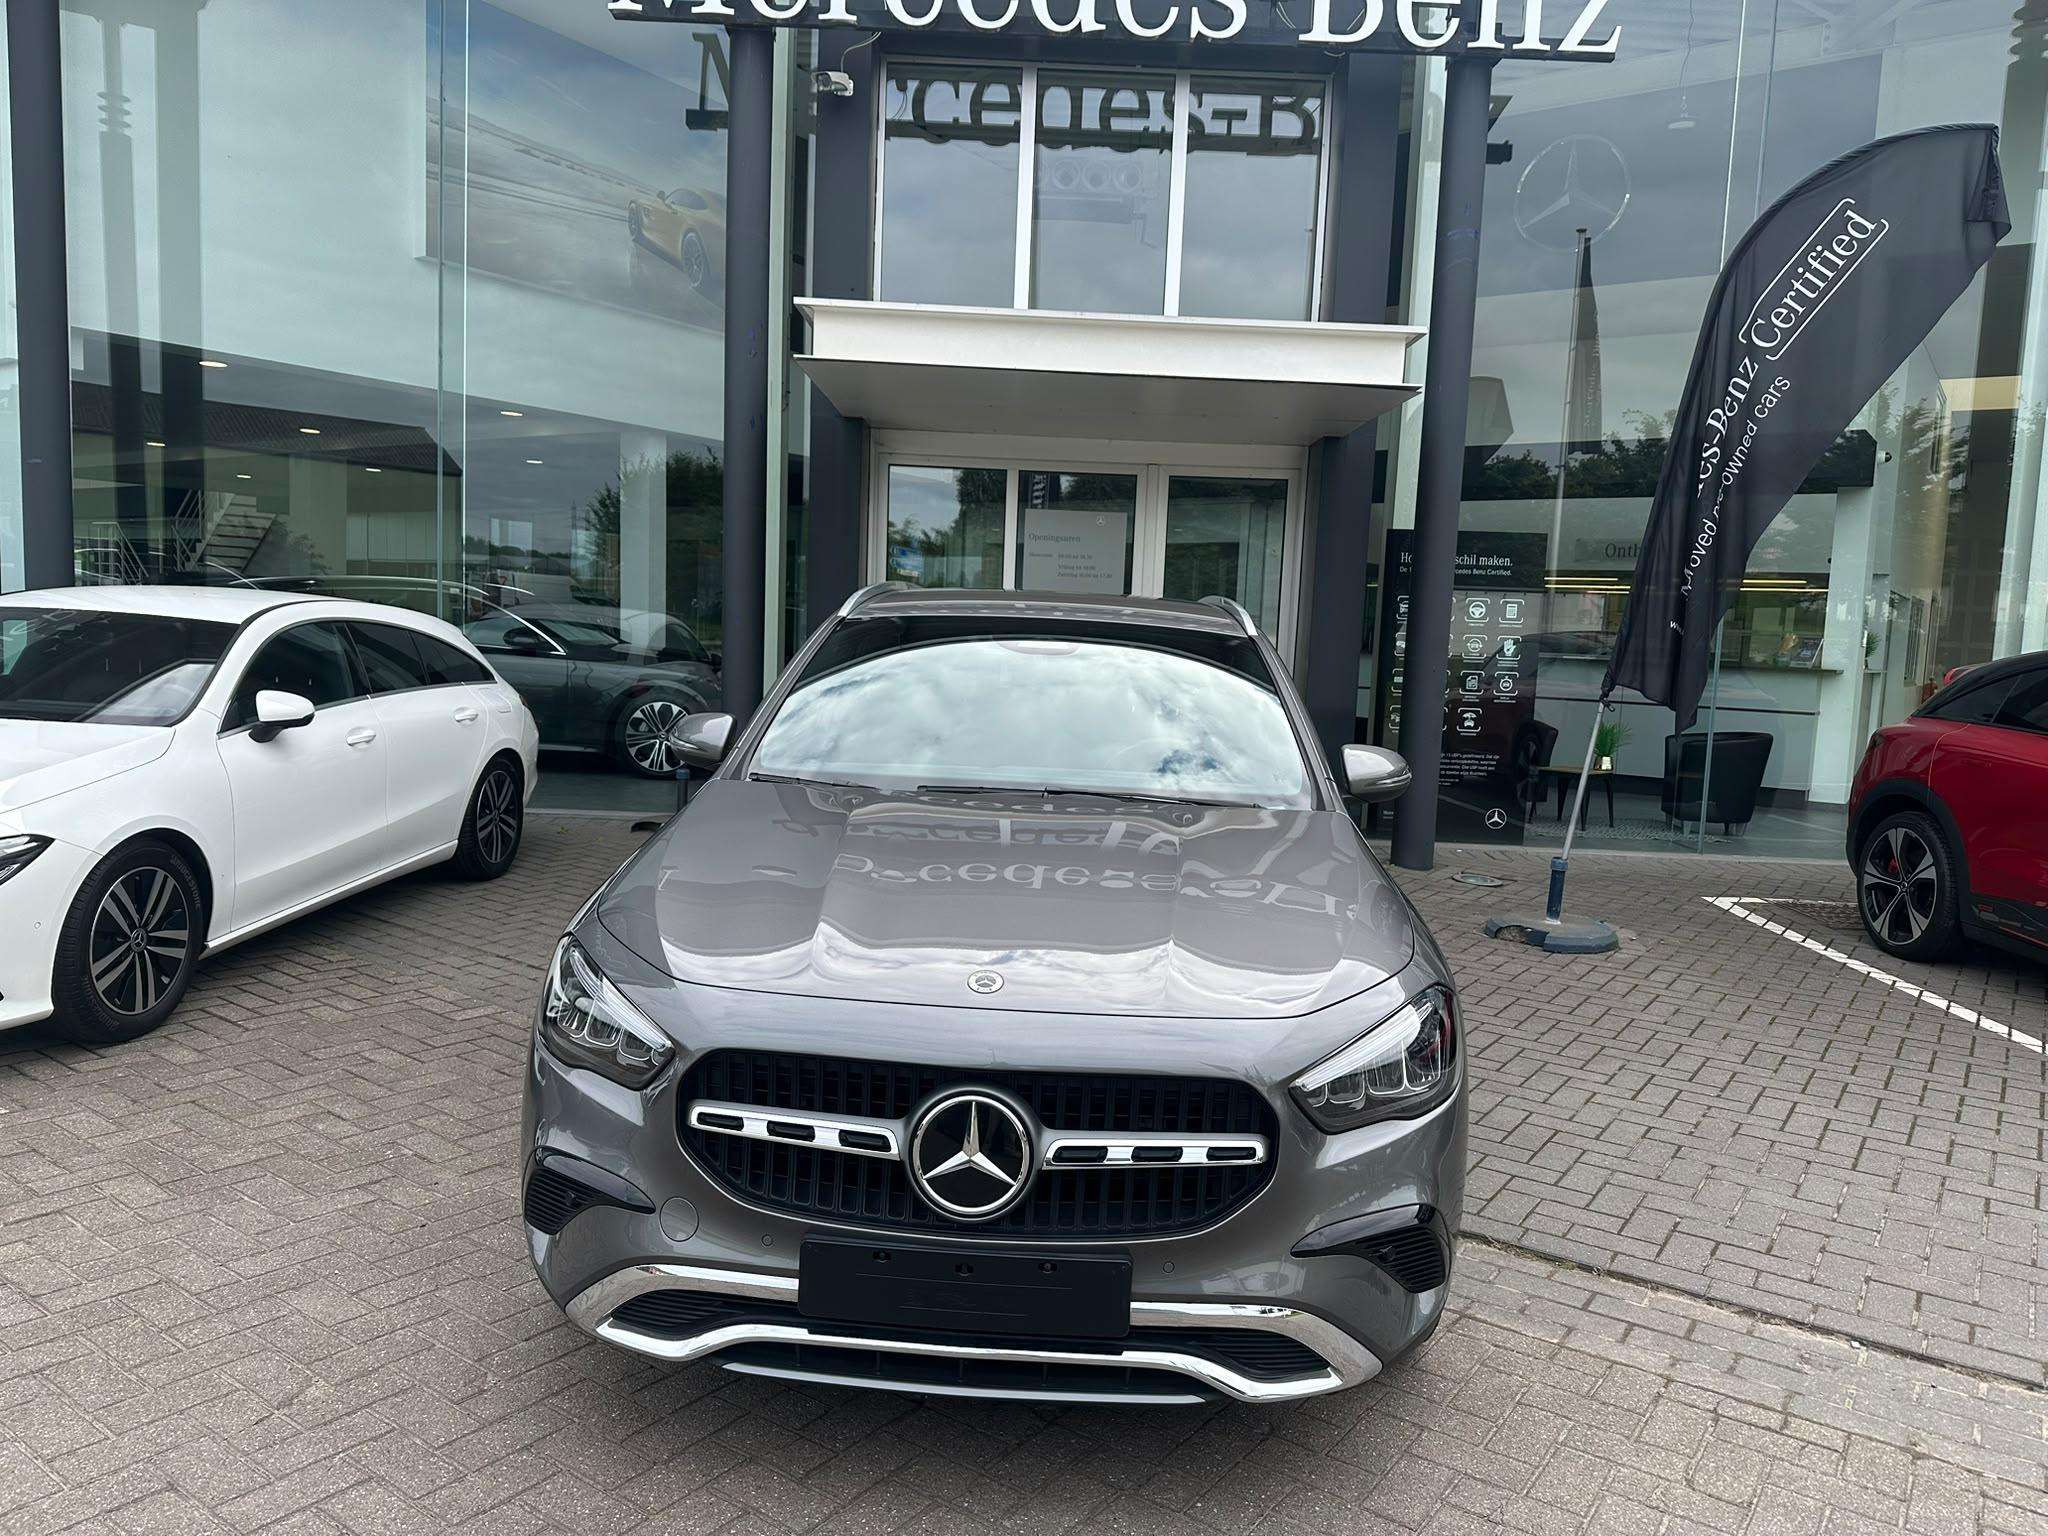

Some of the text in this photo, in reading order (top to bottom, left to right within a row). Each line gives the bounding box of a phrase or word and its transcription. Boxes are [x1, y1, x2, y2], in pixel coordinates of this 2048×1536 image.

[1751, 209, 1877, 347] Certified
[1754, 376, 1791, 419] cars
[1455, 554, 1477, 565] schil
[1479, 555, 1514, 566] maken.
